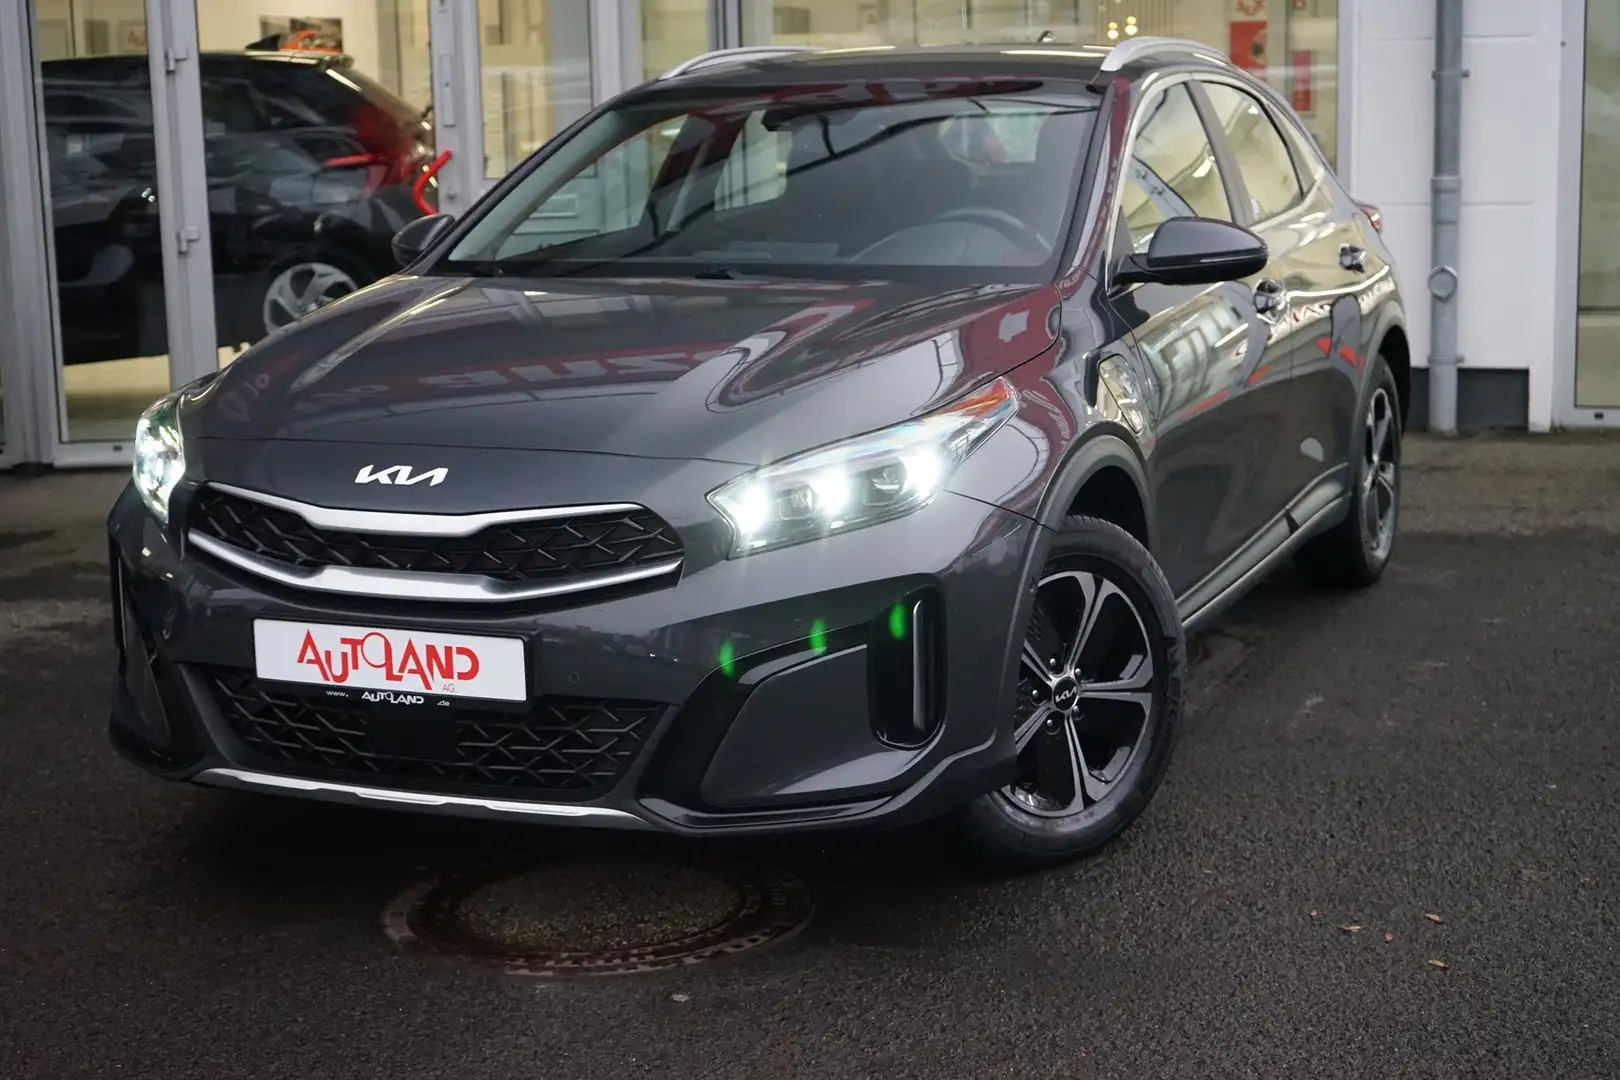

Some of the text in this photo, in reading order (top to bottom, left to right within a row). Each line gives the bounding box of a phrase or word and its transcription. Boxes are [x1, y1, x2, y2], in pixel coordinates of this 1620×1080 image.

[355, 465, 448, 487] KIA
[442, 683, 455, 693] AG
[1055, 686, 1077, 703] KIA
